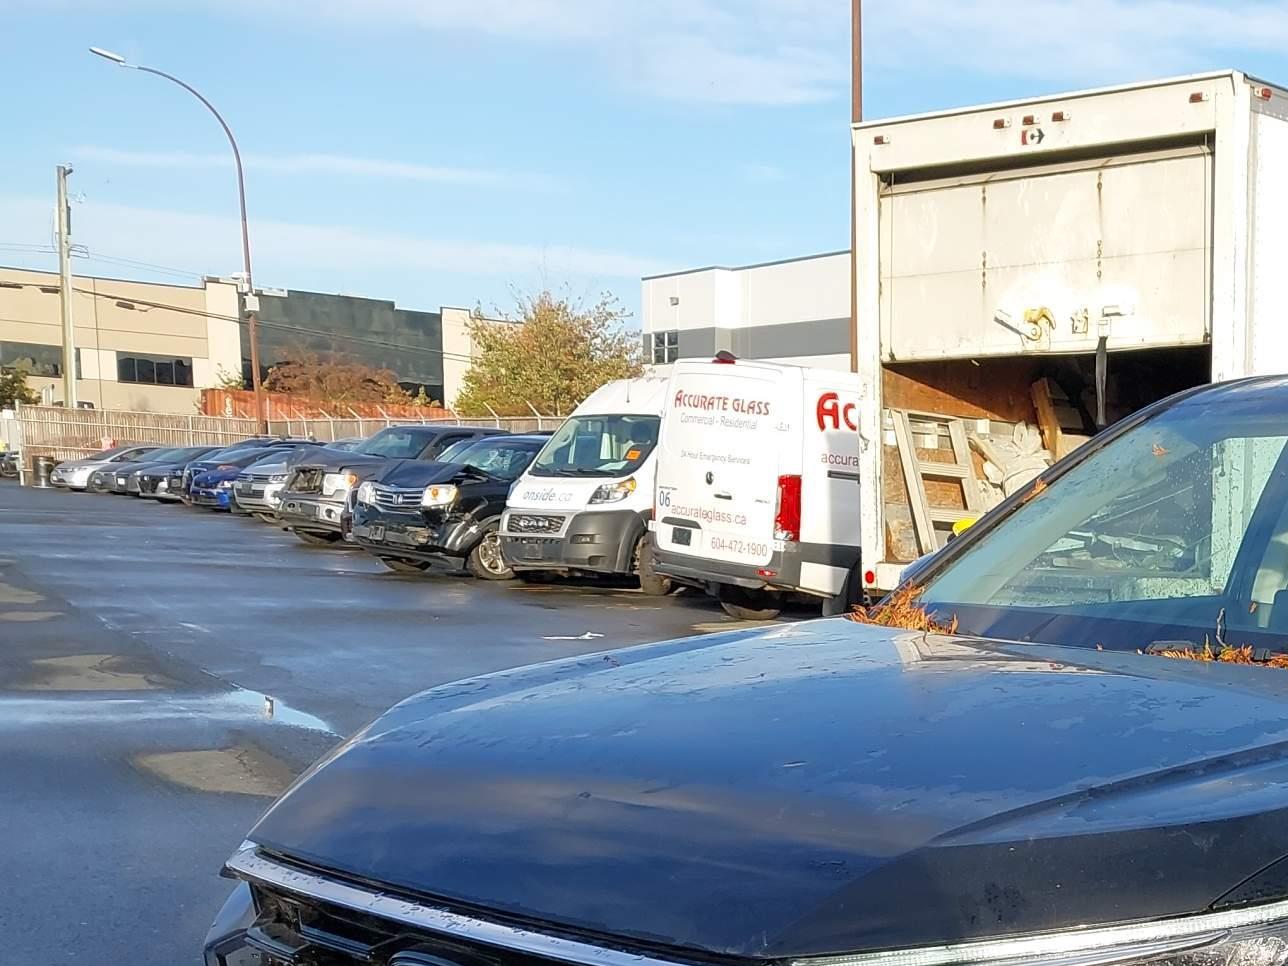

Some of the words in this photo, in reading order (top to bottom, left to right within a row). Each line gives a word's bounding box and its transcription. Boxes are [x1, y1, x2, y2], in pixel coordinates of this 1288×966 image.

[674, 389, 729, 411] ACCURATE
[732, 398, 771, 416] GLASS
[680, 412, 715, 426] Commercial
[719, 415, 758, 430] Residential
[522, 487, 573, 502] onside.ca
[659, 490, 671, 507] 06
[671, 504, 747, 526] accurateglass.ca
[711, 536, 768, 557] 604-472-1900
